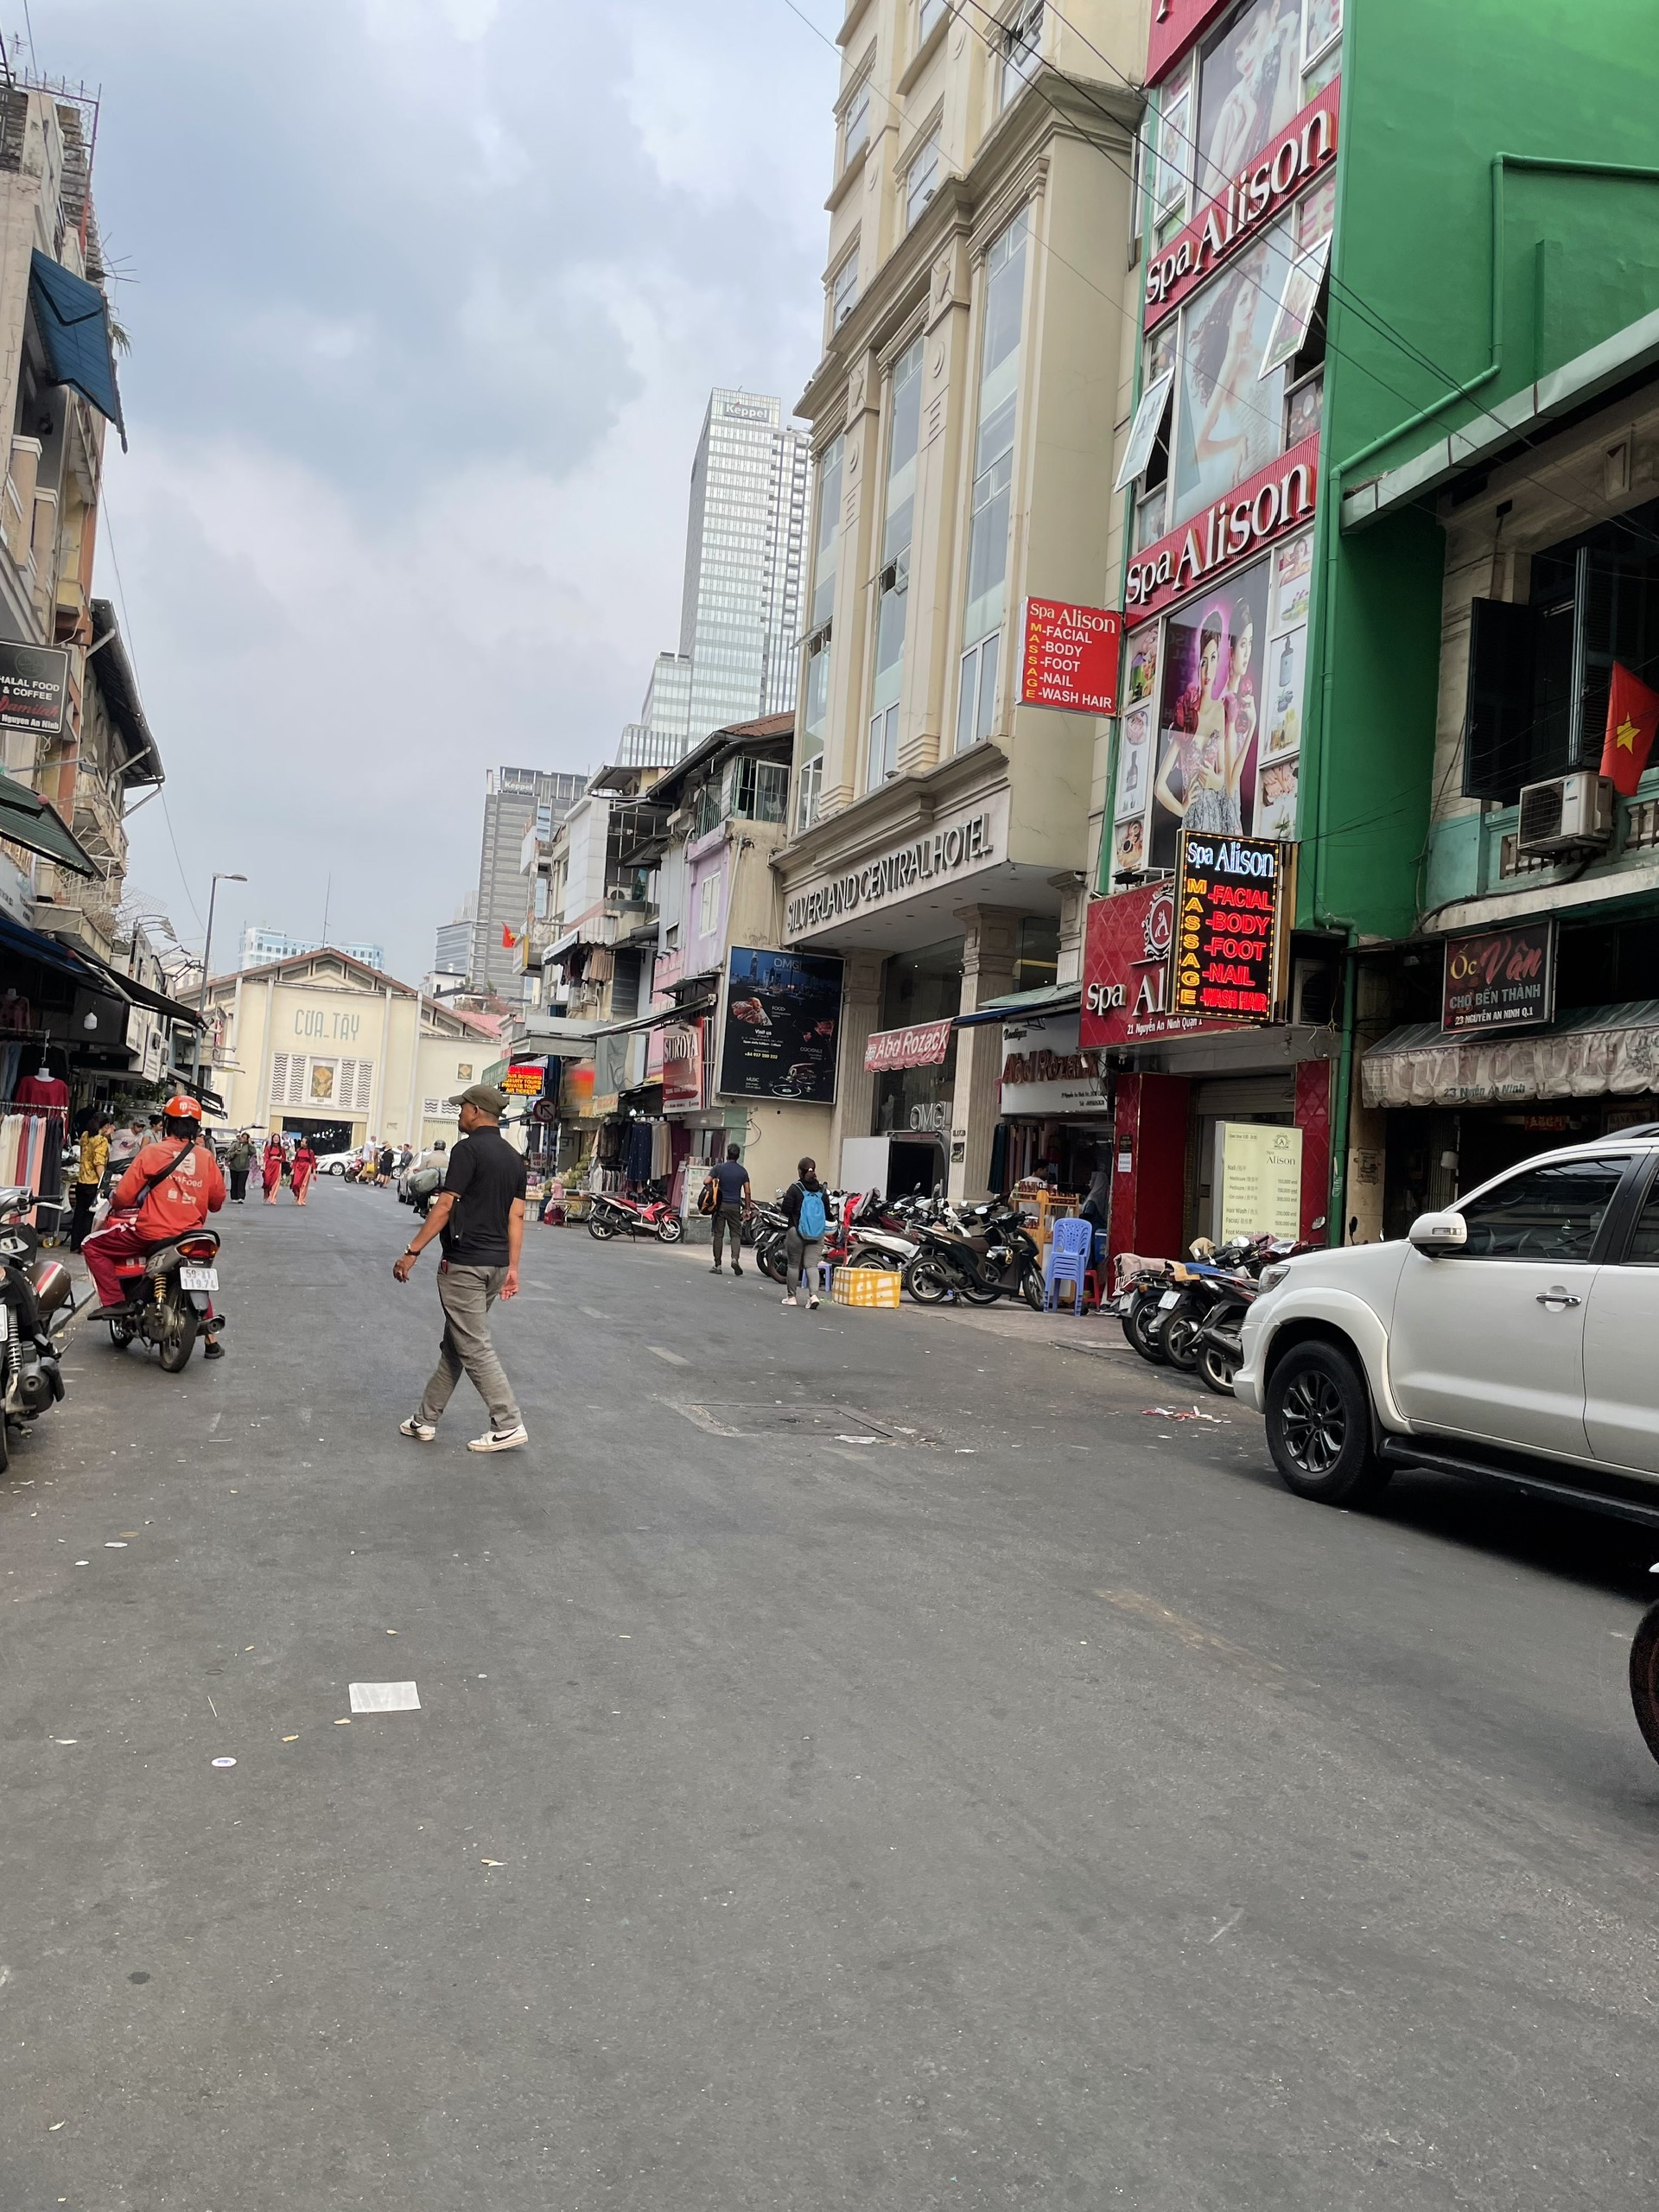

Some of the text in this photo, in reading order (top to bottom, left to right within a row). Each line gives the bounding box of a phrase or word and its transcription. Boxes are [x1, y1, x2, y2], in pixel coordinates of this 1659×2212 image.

[1144, 109, 1334, 304] Spa Alison
[726, 402, 767, 418] Keppel
[1125, 464, 1313, 604] Spa Alison
[1030, 604, 1116, 633] Spa Alison
[13, 688, 53, 701] COFFEE
[33, 681, 60, 692] FOOD
[1082, 694, 1112, 709] HAIR
[30, 718, 41, 728] An
[505, 780, 533, 791] Keppel
[1187, 841, 1274, 878] Spa Alison
[787, 813, 994, 932] SILVERLAND CENTRAL HOTEL
[1451, 944, 1477, 980] Ốc
[1086, 982, 1127, 1016] Spa
[1238, 991, 1267, 1012] HAIR
[1475, 987, 1498, 1006] BẾN
[1501, 983, 1541, 1002] THÀNH
[1156, 1020, 1165, 1032] An
[1455, 1016, 1464, 1026] 23
[1492, 1011, 1503, 1020] AN
[1503, 1007, 1520, 1019] NINH
[1522, 1007, 1534, 1018] Q.1
[664, 1033, 699, 1063] SUROYA
[875, 1033, 902, 1060] Abd
[902, 1024, 949, 1056] Rozack
[910, 1103, 947, 1130] OMG!
[1267, 1156, 1296, 1165] Alison
